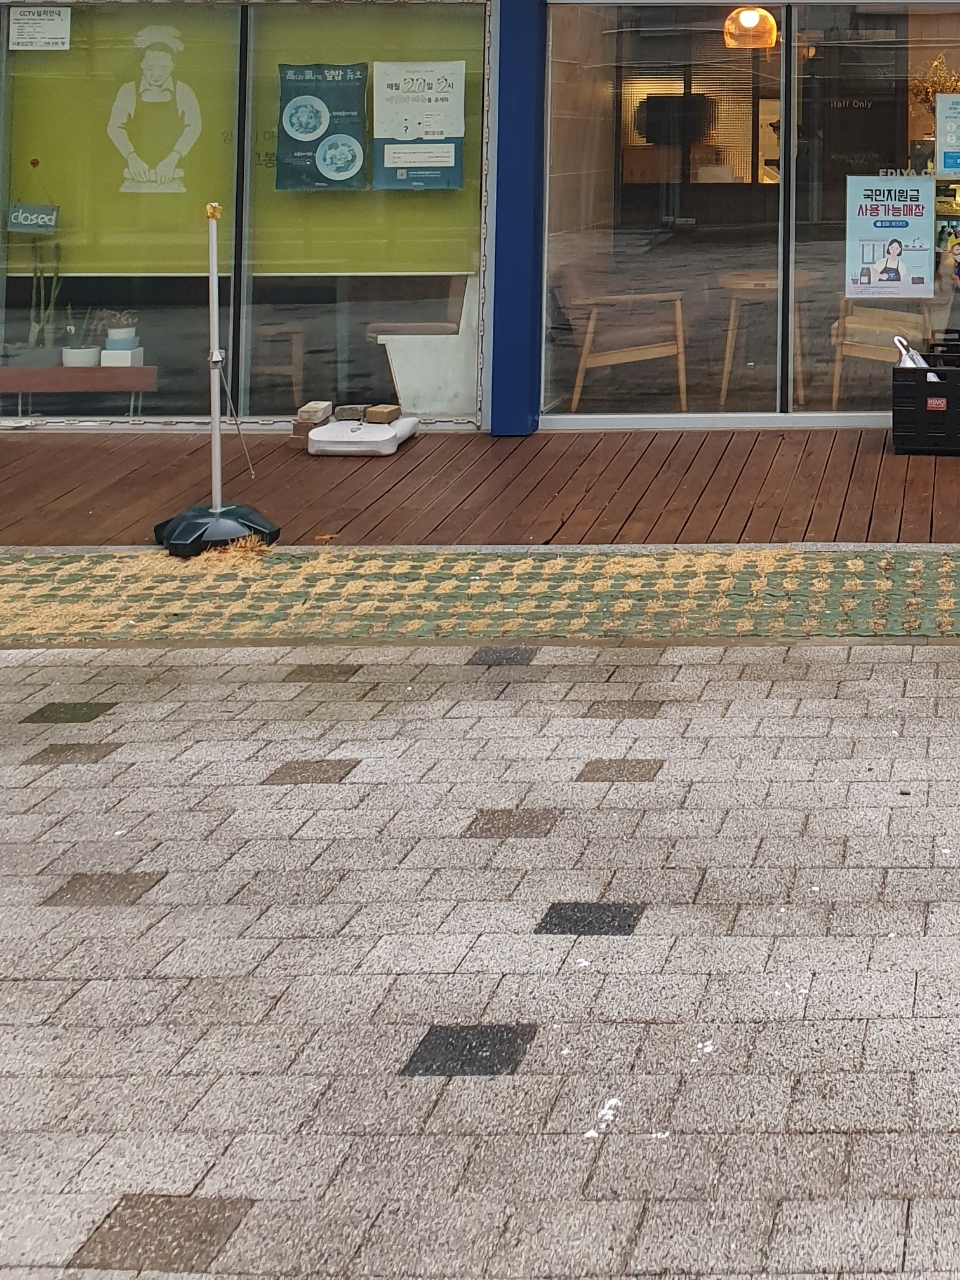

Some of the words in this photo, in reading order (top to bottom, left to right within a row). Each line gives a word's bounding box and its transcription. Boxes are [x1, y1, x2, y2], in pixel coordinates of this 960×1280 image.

[852, 99, 872, 109] Only
[863, 189, 920, 202] 국민지원금
[11, 208, 57, 226] closed
[857, 204, 925, 217] 사용가능매장
